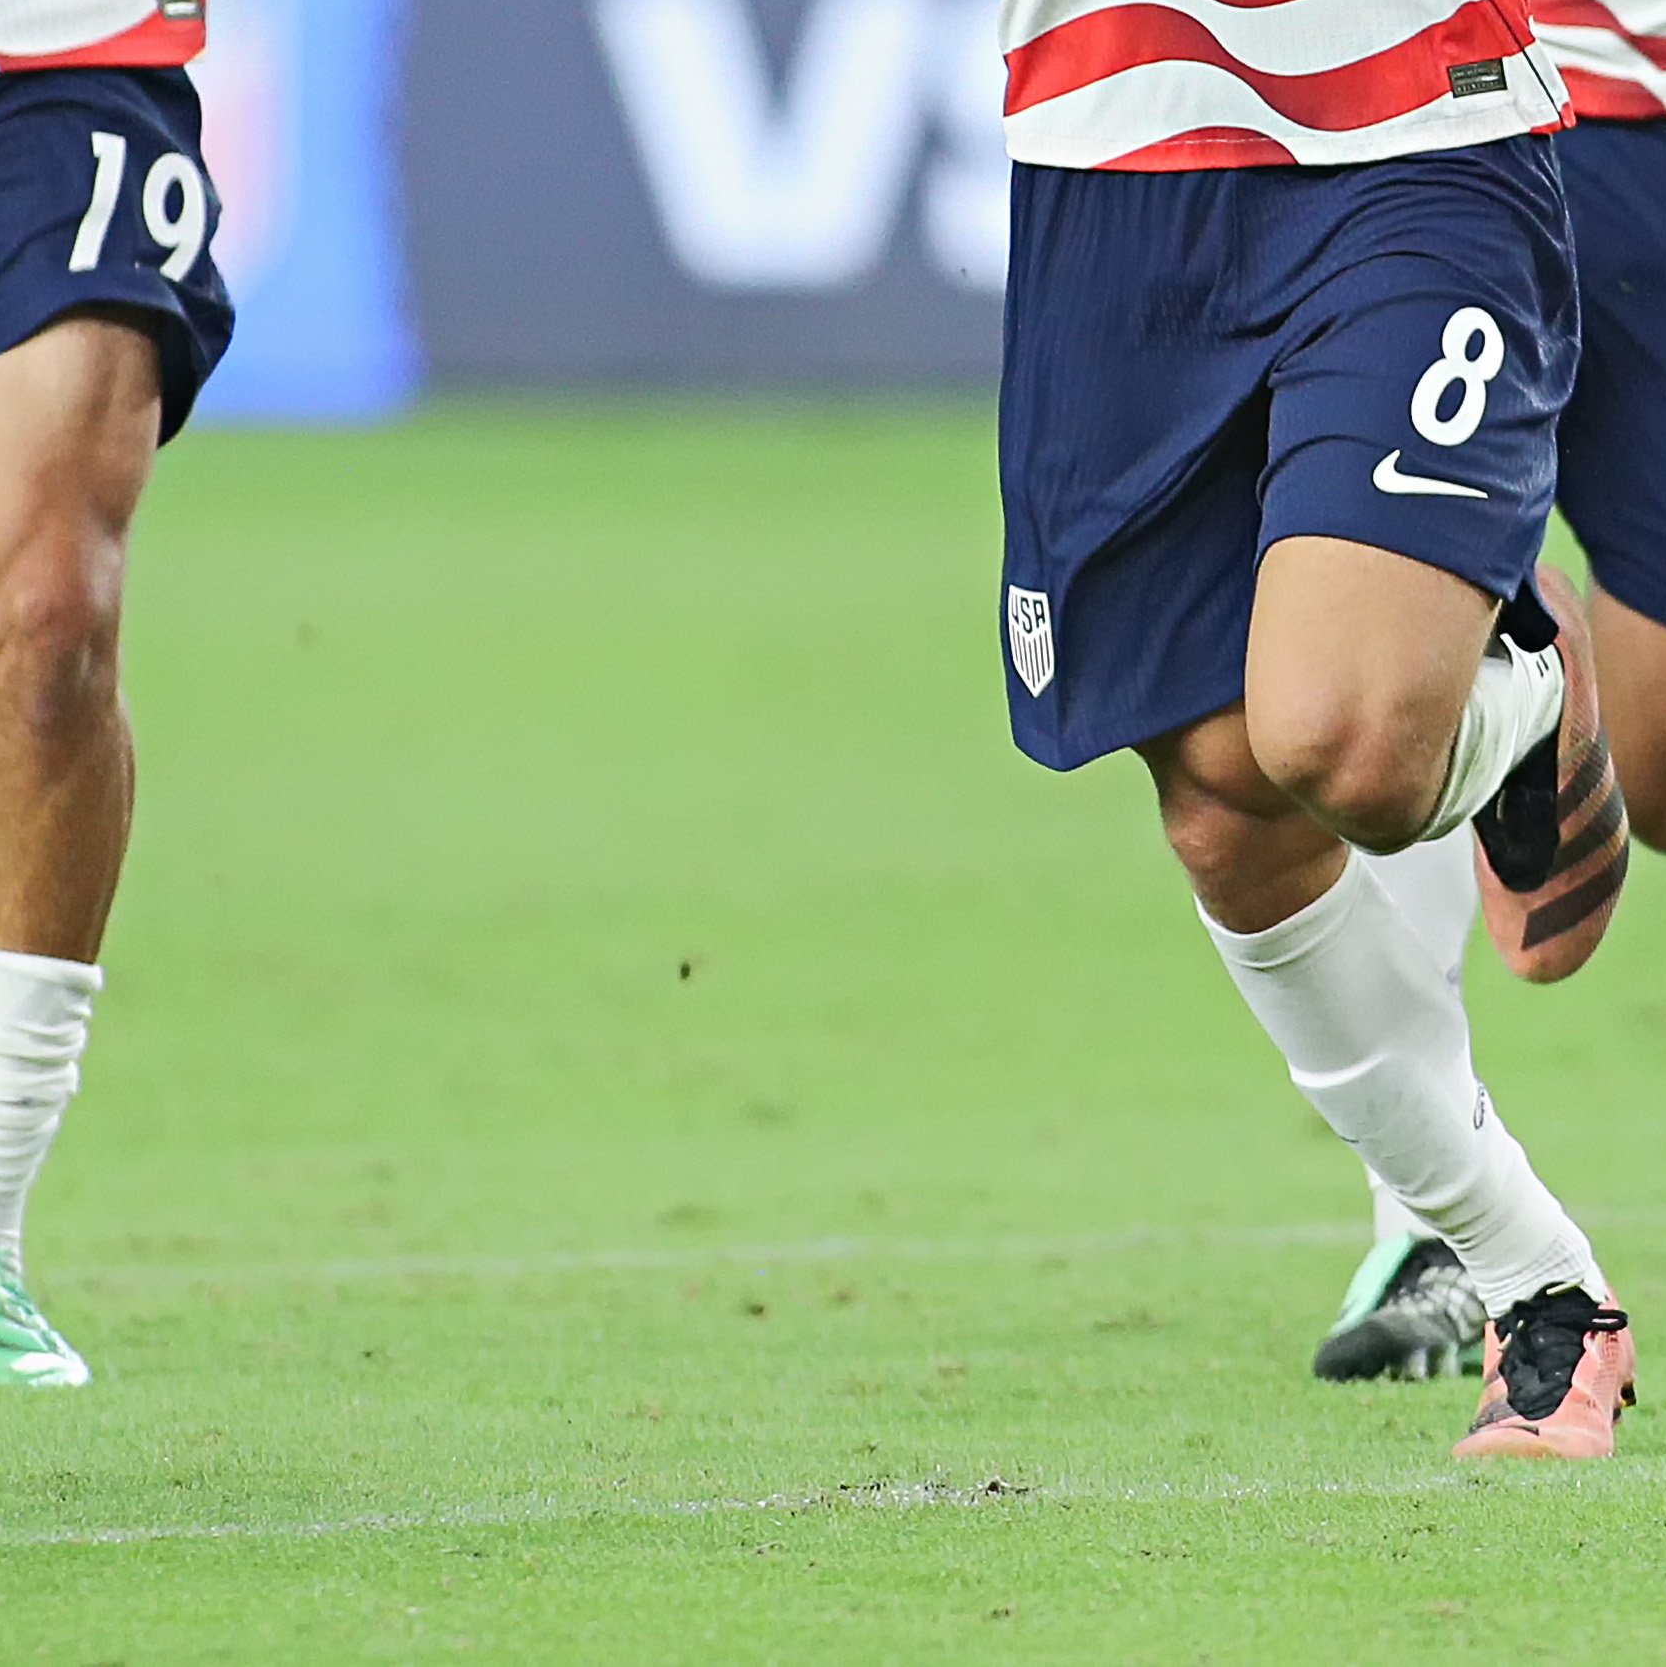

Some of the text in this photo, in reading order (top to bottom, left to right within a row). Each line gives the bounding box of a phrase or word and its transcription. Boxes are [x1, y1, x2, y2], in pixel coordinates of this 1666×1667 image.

[67, 131, 210, 282] 19
[1410, 307, 1506, 447] 8
[1011, 593, 1046, 635] USA
